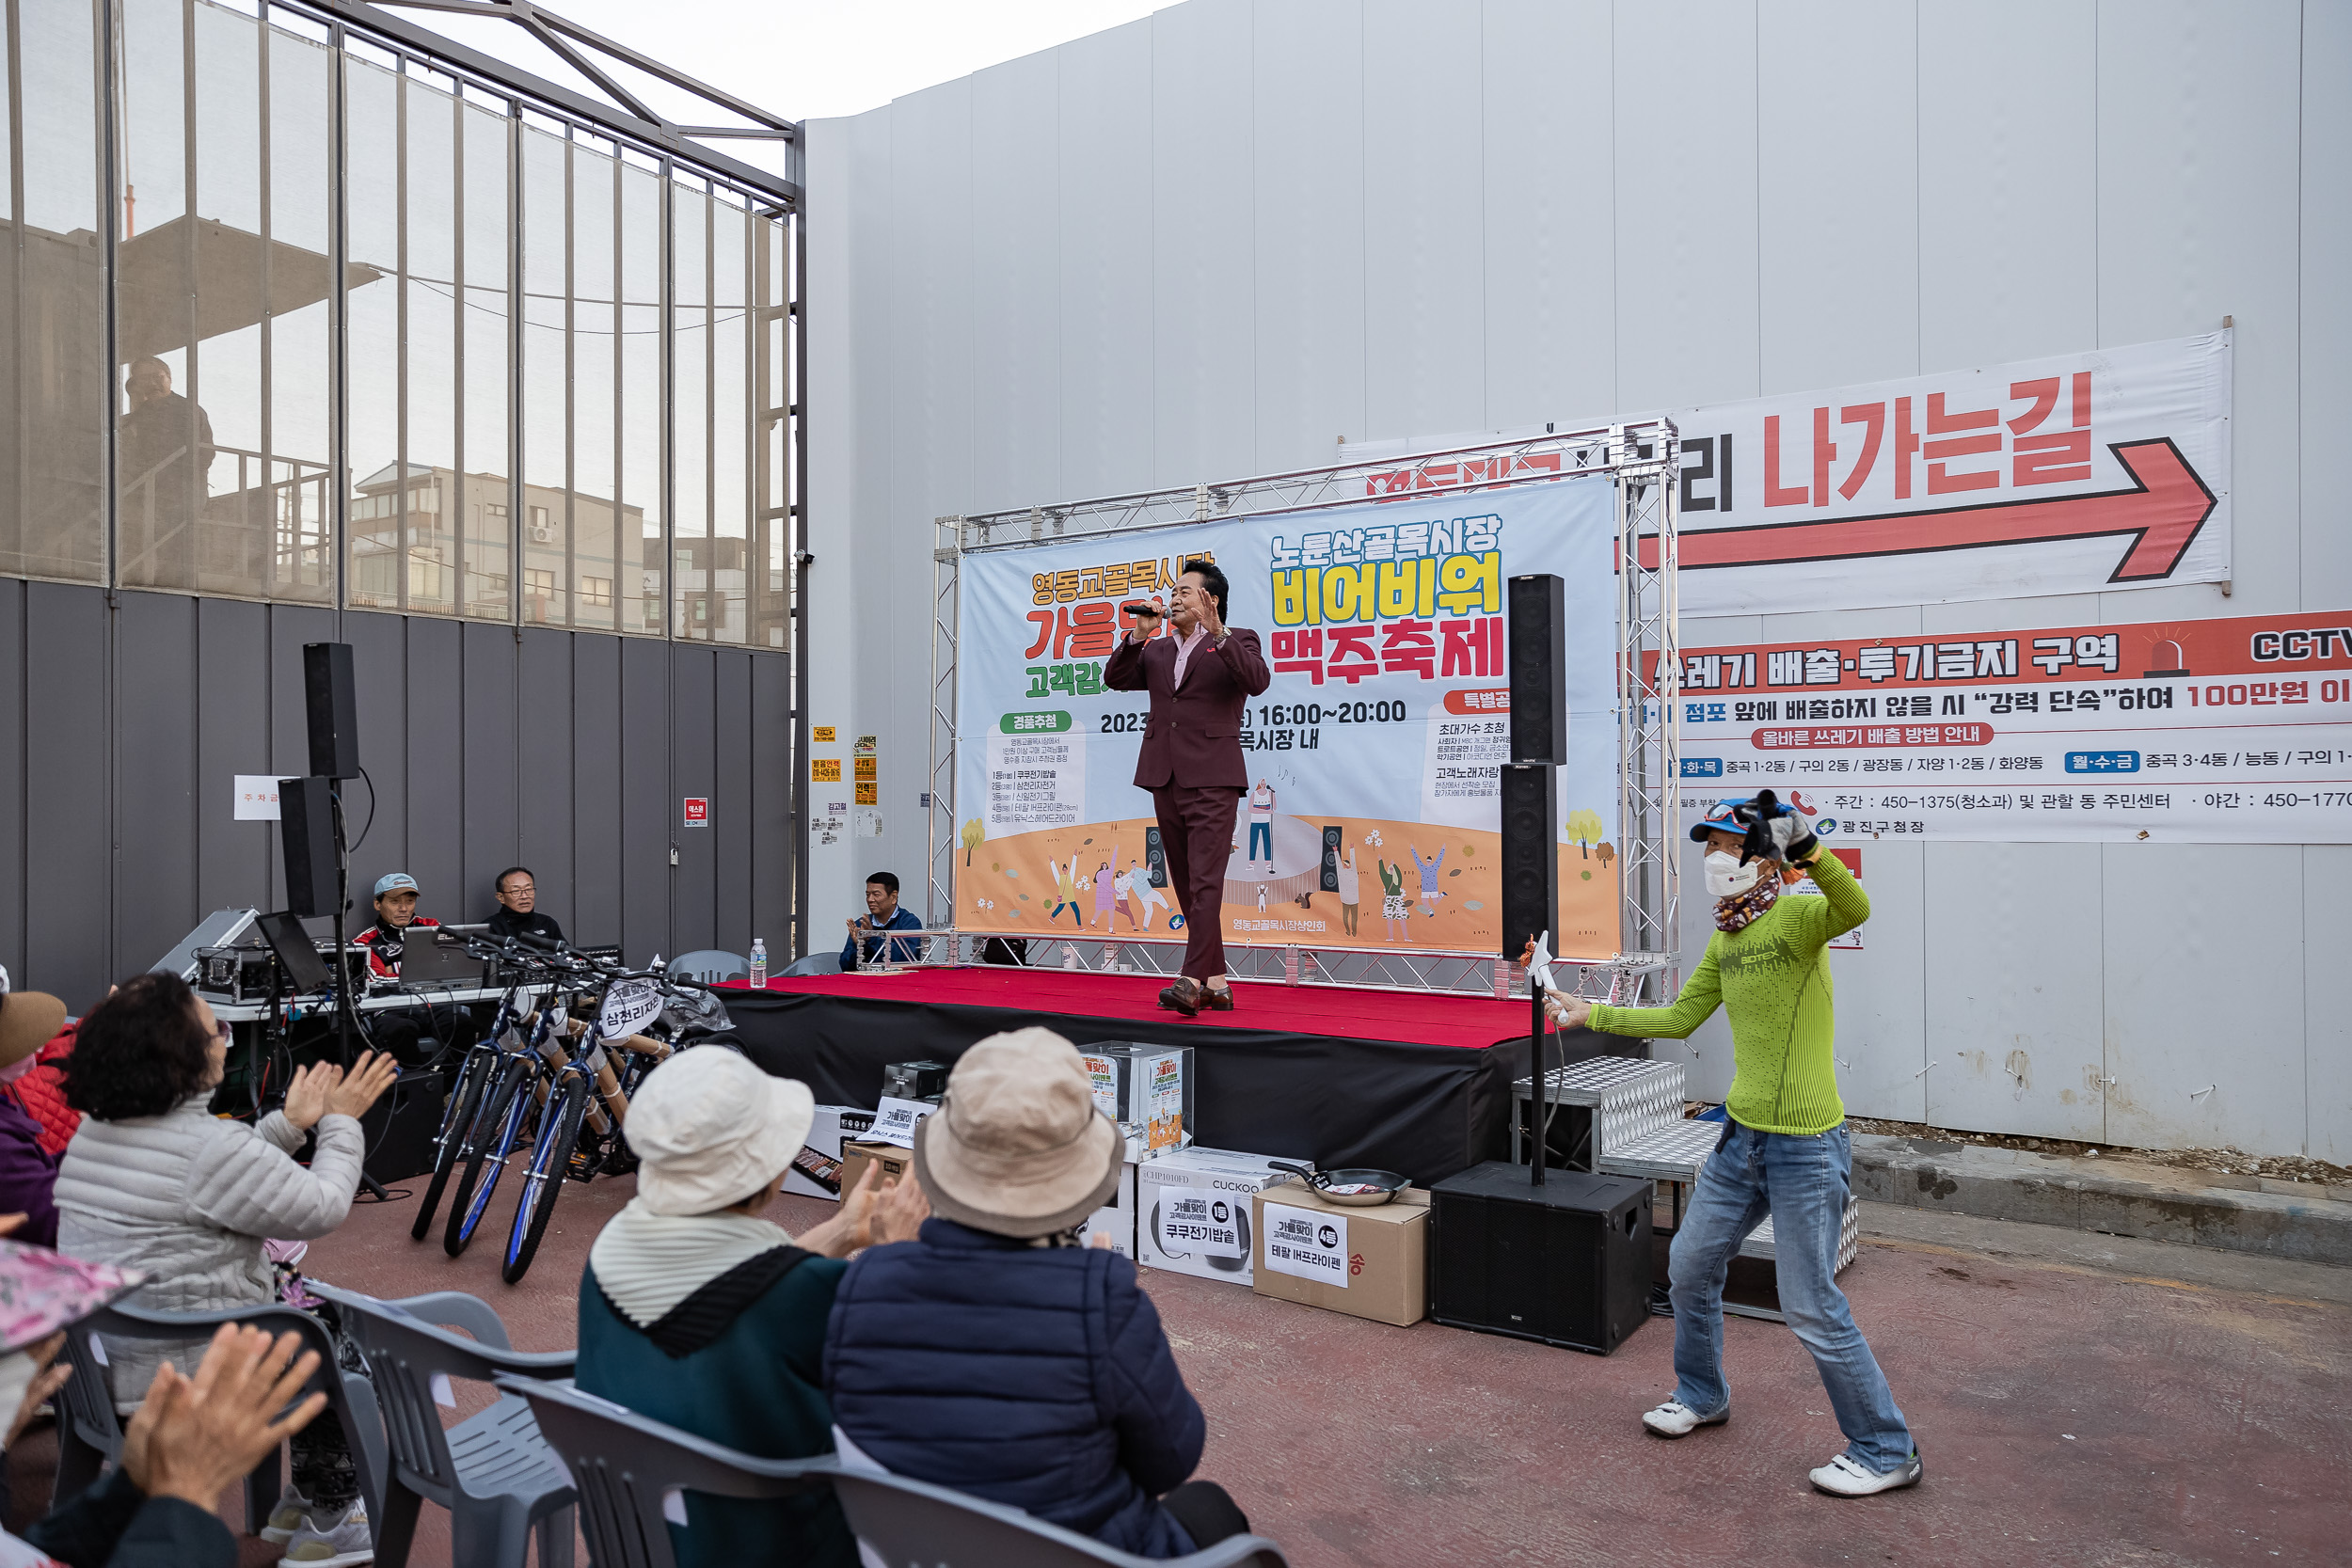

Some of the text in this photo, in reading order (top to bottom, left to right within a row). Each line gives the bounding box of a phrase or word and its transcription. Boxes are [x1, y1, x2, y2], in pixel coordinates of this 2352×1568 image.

[1763, 371, 2091, 509] 나가는길
[1271, 514, 1503, 567] 노룬산골목시장
[1271, 551, 1503, 626] 비어비워
[1271, 617, 1504, 686] 맥주축제
[1654, 633, 2120, 690] 쓰레기 배출·투기금지 구역
[1025, 661, 1125, 698] 고객감
[1685, 702, 1726, 723] 점포
[1735, 700, 1777, 721] 앞에
[1786, 696, 1877, 721] 배출하지
[1885, 694, 1932, 718] 않을
[1942, 692, 1965, 716] 시
[2187, 679, 2309, 707] 100만원
[1259, 700, 1406, 726] 16:00~20:00
[1013, 714, 1057, 730] 경품추첨
[1439, 721, 1505, 736] 초대가수 초청
[1300, 727, 1320, 750] 내
[1761, 725, 1980, 747] 올바른 쓰레기 배출 방법 안내
[1725, 760, 1751, 773] 중곡
[1754, 758, 1787, 772] 1·2동
[1798, 758, 1824, 772] 구의
[1828, 757, 1850, 771] 2동
[1862, 757, 1903, 771] 광장동
[1916, 756, 1946, 771] 자양
[1949, 756, 1985, 771] 1·2동
[1998, 756, 2043, 770] 화양동
[2072, 754, 2134, 769] 월·수·금
[2146, 753, 2178, 768] 중곡
[2182, 752, 2227, 768] 3·4동
[2245, 752, 2280, 767] 능동
[2297, 751, 2331, 765] 구의
[1436, 767, 1500, 779] 고객노래자랑
[1016, 781, 1056, 790] 삼천리자전거
[1834, 795, 1863, 810] 주간
[2019, 794, 2035, 809] 및
[2041, 793, 2074, 809] 관할
[2079, 793, 2094, 809] 동
[2103, 793, 2170, 809] 주민센터
[2204, 793, 2240, 809] 야간
[1841, 820, 1926, 834] 광진구청장
[1232, 918, 1327, 933] 영동교골목시장상인회
[1212, 1180, 1260, 1195] CUCKOO
[1173, 1202, 1207, 1214] 가을맞이
[1213, 1205, 1229, 1220] 1등
[1167, 1224, 1235, 1244] 쿠쿠전기밥솥
[1278, 1221, 1313, 1238] 가을맞이
[1319, 1229, 1337, 1245] 4등
[1271, 1244, 1291, 1259] 테팔
